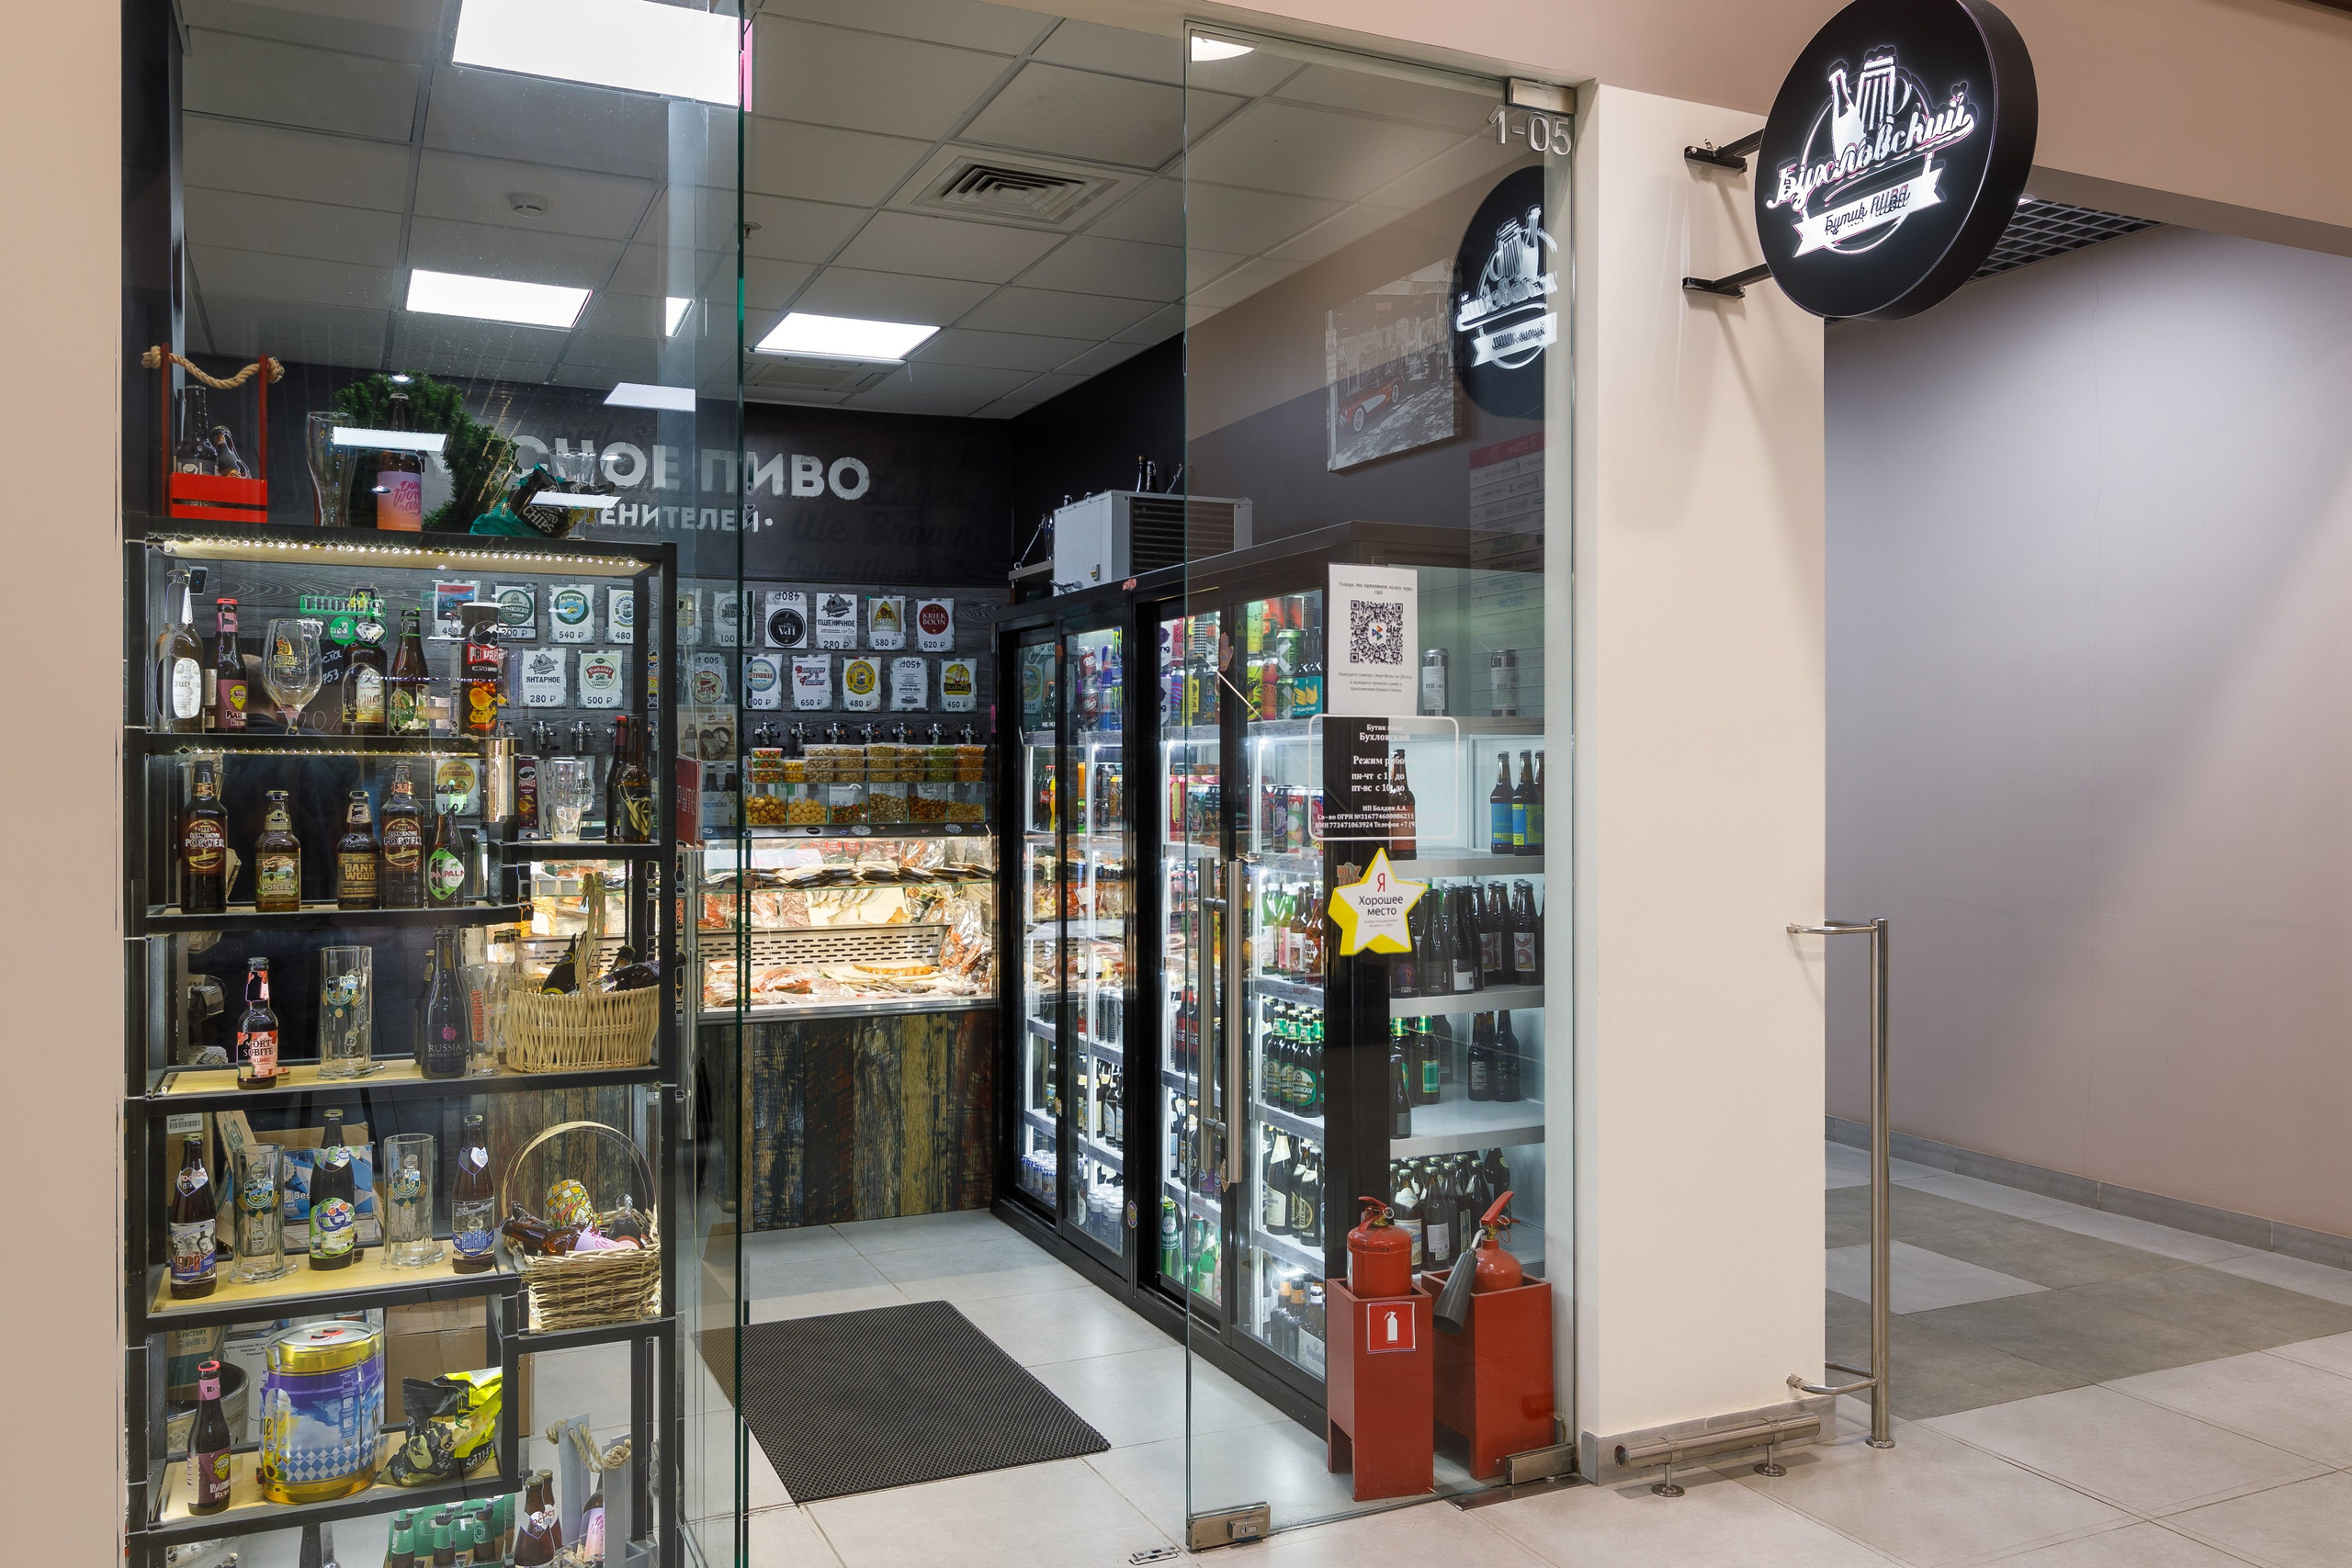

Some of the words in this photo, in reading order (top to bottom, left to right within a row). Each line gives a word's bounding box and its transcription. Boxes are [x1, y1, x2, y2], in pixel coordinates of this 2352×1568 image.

[1486, 104, 1572, 155] 1-05
[1766, 92, 1976, 210] Бухловский
[700, 448, 870, 501] ПИВО
[523, 505, 554, 534] CHIPS
[586, 503, 760, 533] ЕНИТЕЛЕЙ
[818, 619, 855, 627] ПШЕНИЧНОЕ
[559, 630, 575, 639] 540
[615, 631, 631, 640] 480
[875, 638, 889, 647] 580
[923, 640, 938, 649] 620
[529, 694, 547, 704] 280
[587, 696, 604, 705] 500
[849, 699, 864, 707] 480
[1366, 724, 1386, 733] Бутик
[1359, 732, 1410, 743] Бухловский
[1352, 755, 1384, 765] Режим
[1351, 772, 1374, 781] пн-чт
[1351, 784, 1373, 793] пт-вс
[1373, 805, 1396, 813] Болдин
[185, 838, 225, 849] PORTER
[383, 837, 423, 846] PORTER
[345, 872, 376, 881] WOOD
[262, 883, 296, 891] PORTER
[1377, 873, 1385, 893] Я
[1358, 895, 1404, 908] Хорошее
[1367, 907, 1397, 917] место
[245, 1040, 272, 1048] MORT
[243, 1047, 274, 1057] SUBITE
[461, 1229, 487, 1249] 1980
[174, 1255, 202, 1272] 1970
[181, 1328, 207, 1338] FACTORY
